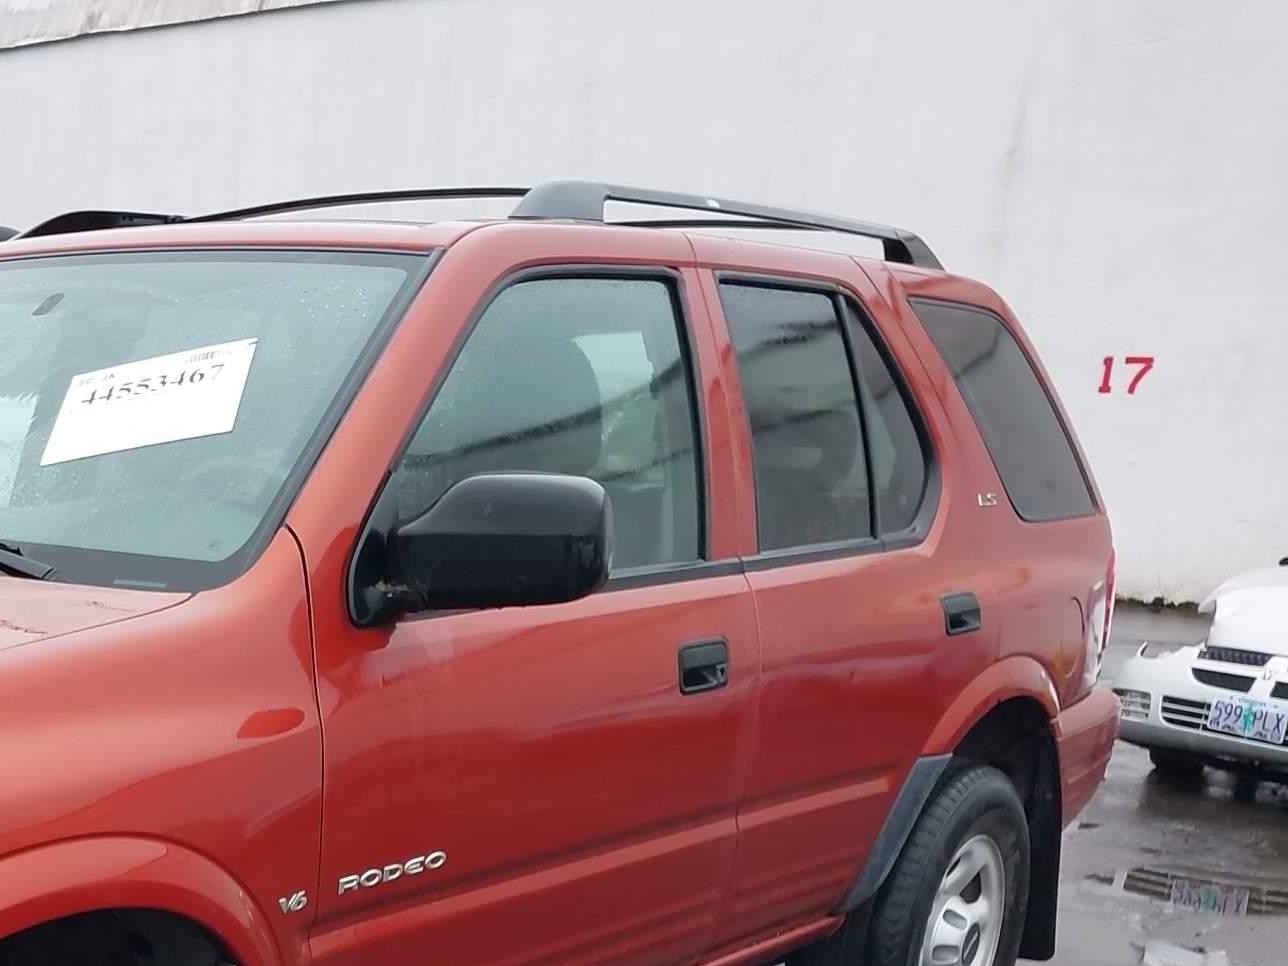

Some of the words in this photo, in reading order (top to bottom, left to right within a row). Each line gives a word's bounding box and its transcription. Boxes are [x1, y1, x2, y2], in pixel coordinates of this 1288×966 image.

[81, 363, 225, 405] 44553467
[1098, 356, 1154, 394] 17
[977, 493, 997, 507] LS
[1214, 700, 1244, 724] 599
[1252, 710, 1285, 734] PLX
[338, 851, 447, 895] RODEO
[278, 890, 308, 914] V6
